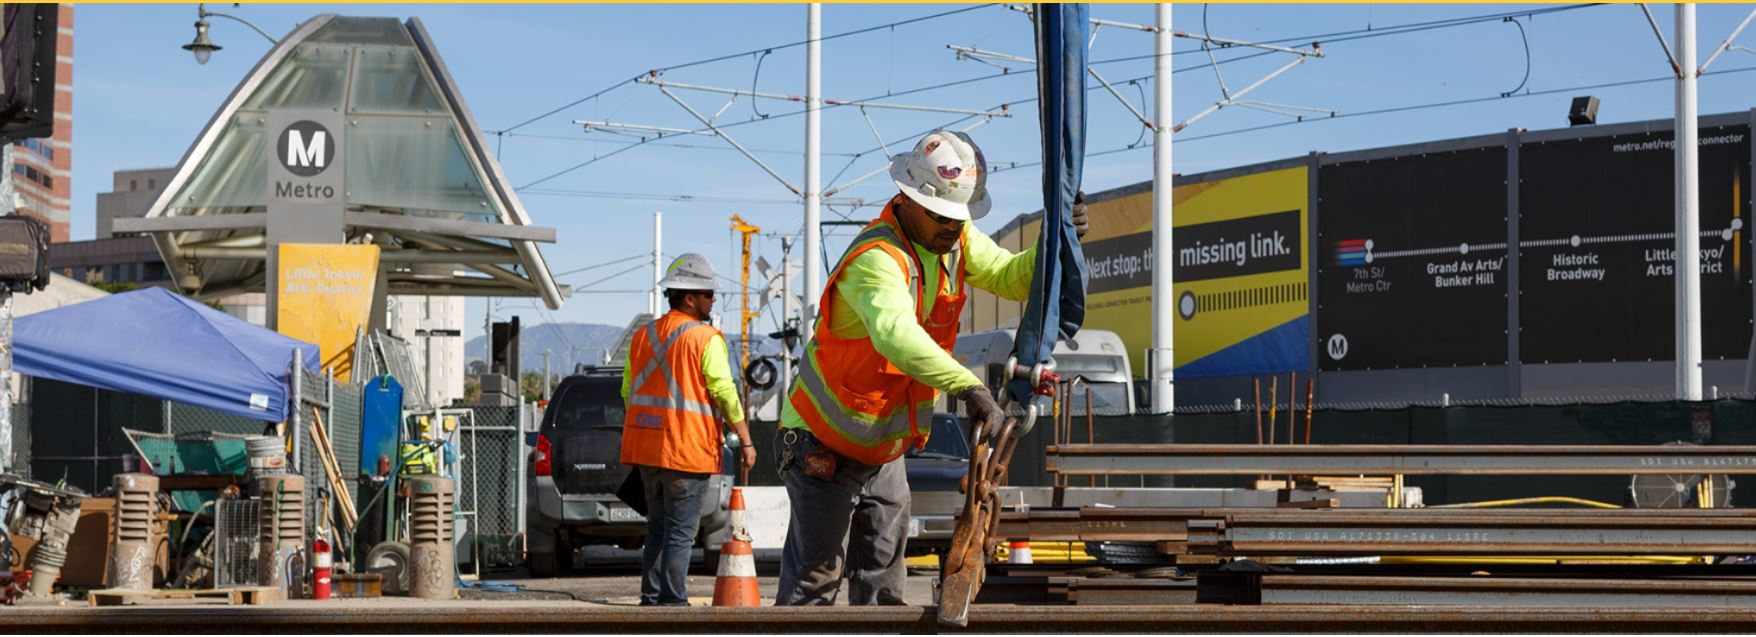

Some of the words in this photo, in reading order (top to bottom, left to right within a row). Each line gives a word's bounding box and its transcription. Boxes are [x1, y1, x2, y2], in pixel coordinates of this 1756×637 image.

[287, 129, 326, 168] M
[275, 181, 335, 199] Metro
[1086, 256, 1111, 279] Next
[1112, 254, 1141, 279] stop:
[1143, 247, 1154, 271] th
[1180, 237, 1246, 267] missing
[1250, 230, 1291, 258] link.
[1553, 252, 1599, 266] Historic
[1645, 248, 1677, 262] Little
[1353, 267, 1369, 279] 7th
[1370, 266, 1385, 279] St/
[1427, 261, 1458, 274] Grand
[1460, 260, 1473, 272] Av
[1475, 257, 1503, 271] Arts/
[1646, 263, 1673, 276] Arts
[1435, 275, 1473, 287] Bunker
[1475, 272, 1494, 285] Hill
[1547, 267, 1605, 281] Broadway
[1347, 282, 1374, 293] Metro
[1376, 280, 1391, 291] Ctr
[1331, 338, 1344, 355] M
